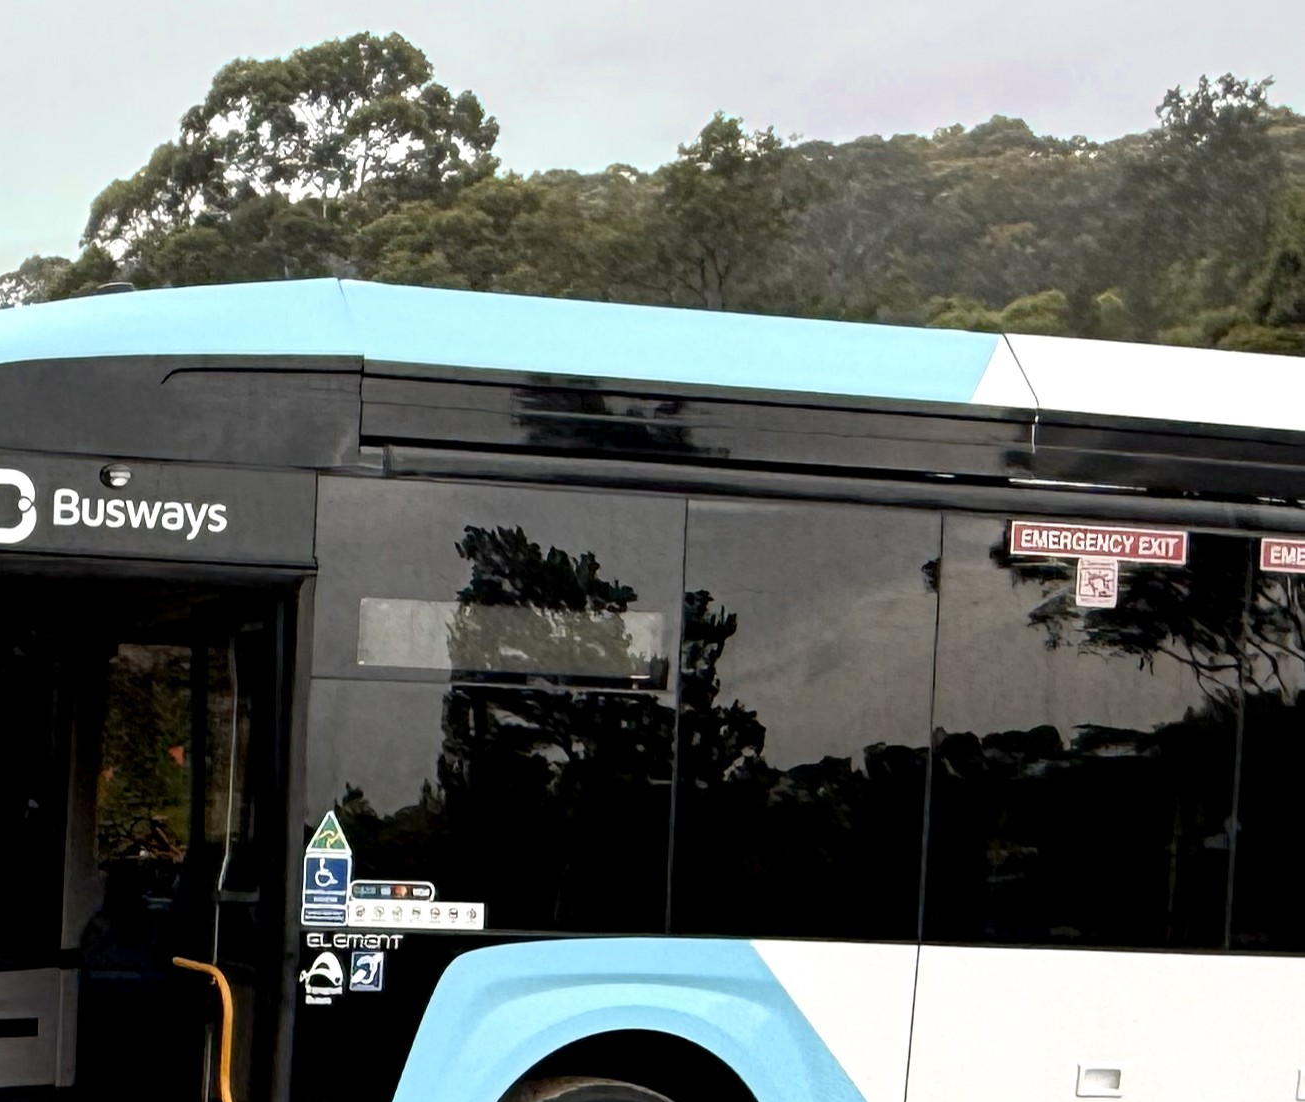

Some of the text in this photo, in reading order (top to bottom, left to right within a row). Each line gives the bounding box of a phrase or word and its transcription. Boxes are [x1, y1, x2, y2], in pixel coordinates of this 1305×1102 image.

[53, 488, 228, 540] Busways
[1021, 529, 1179, 558] EMERGENCY EXIT
[306, 932, 404, 949] ELEMENT
